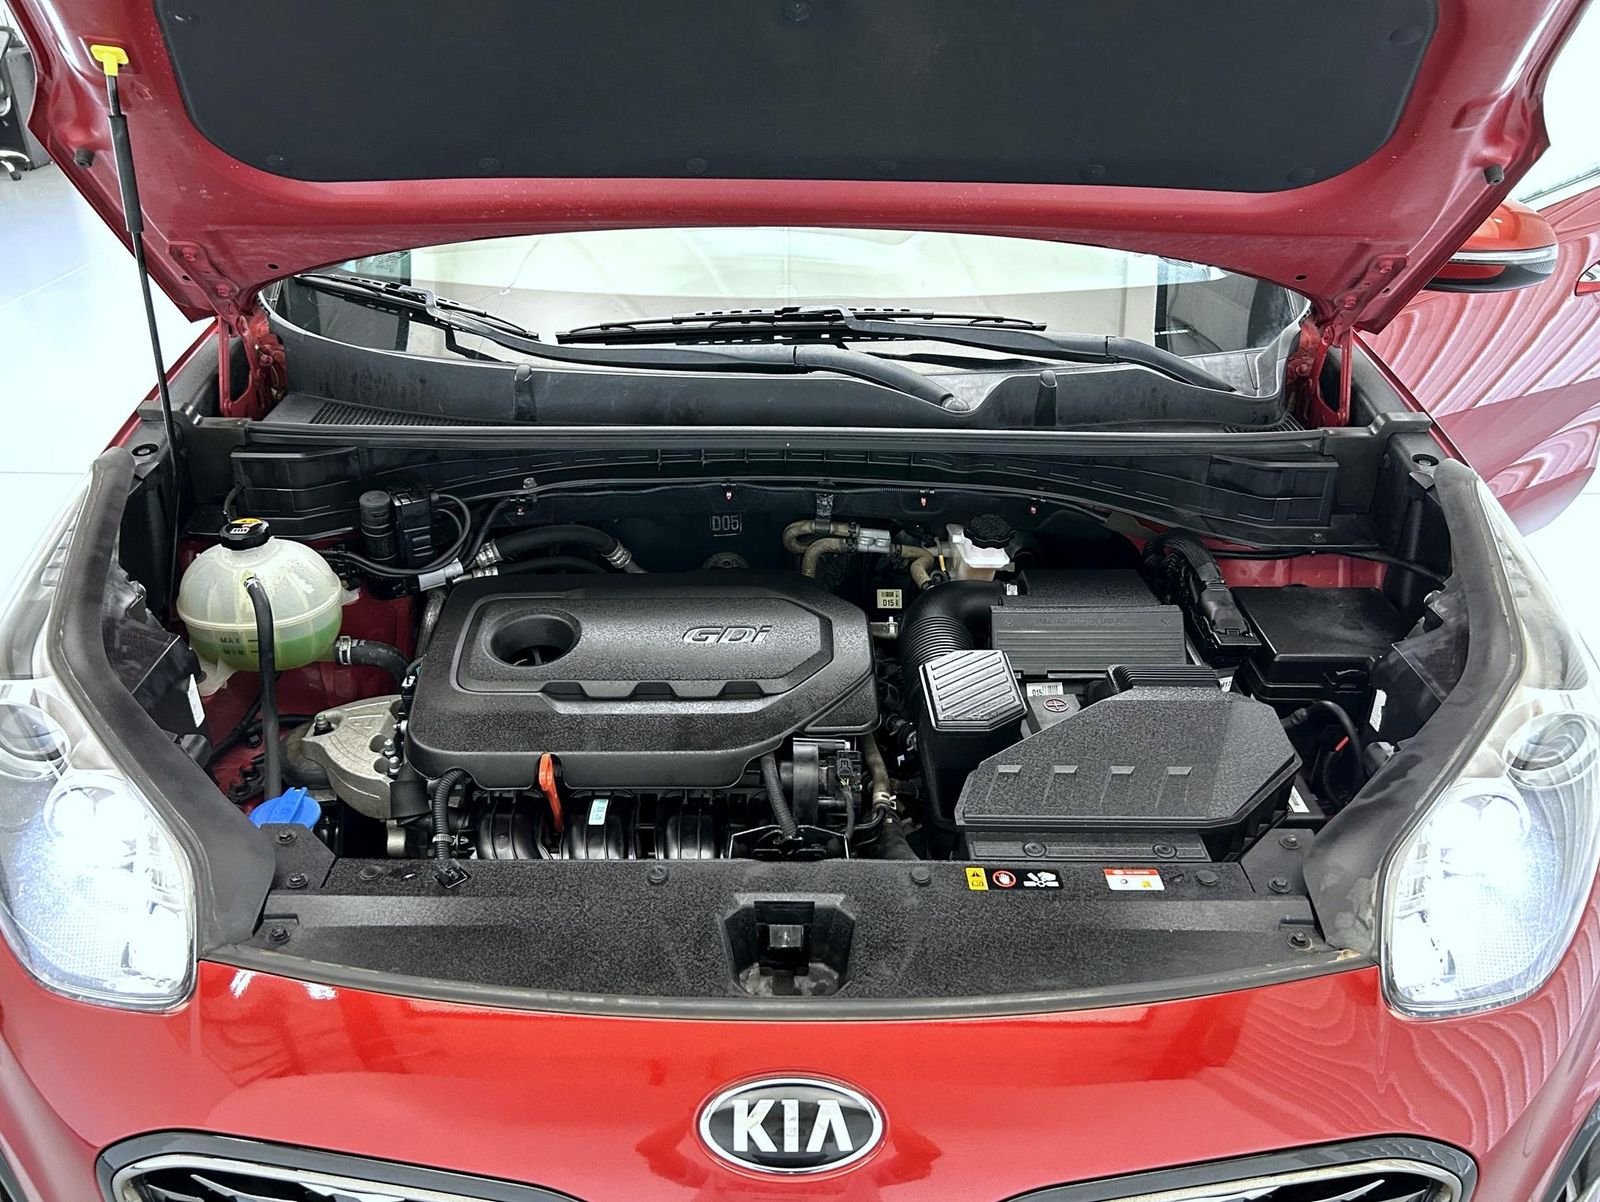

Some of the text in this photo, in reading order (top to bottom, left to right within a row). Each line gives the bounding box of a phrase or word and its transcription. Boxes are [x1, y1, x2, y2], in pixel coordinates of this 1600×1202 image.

[712, 515, 739, 531] D05
[682, 625, 773, 643] GDi
[731, 1099, 854, 1152] KIA
